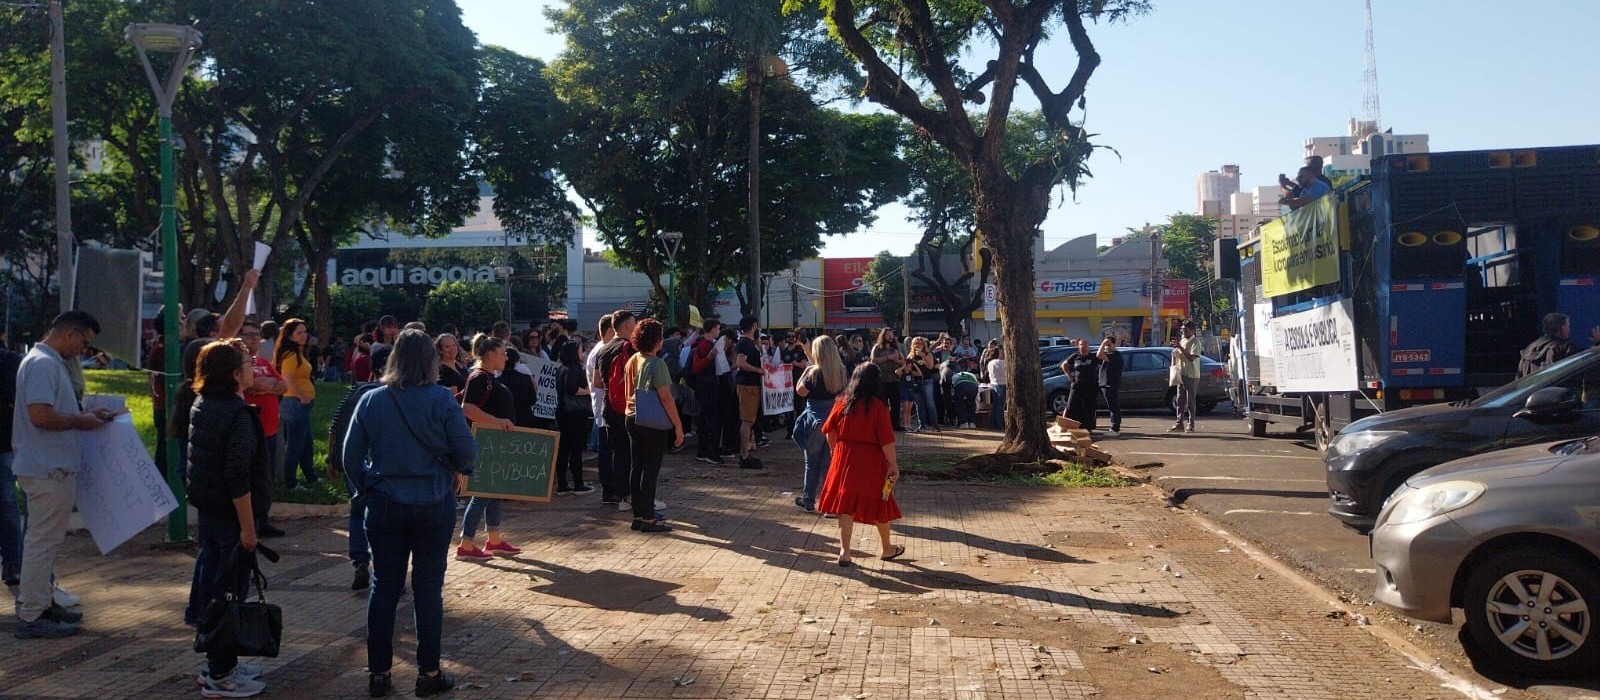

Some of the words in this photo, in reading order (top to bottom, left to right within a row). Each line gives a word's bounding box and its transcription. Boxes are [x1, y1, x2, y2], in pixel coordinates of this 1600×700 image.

[341, 264, 404, 288] aqui
[409, 264, 496, 287] agora
[1054, 280, 1097, 292] nissei
[1288, 324, 1310, 351] ESCOLA
[540, 363, 558, 376] NÃO
[537, 376, 556, 389] NOS
[481, 436, 494, 456] A
